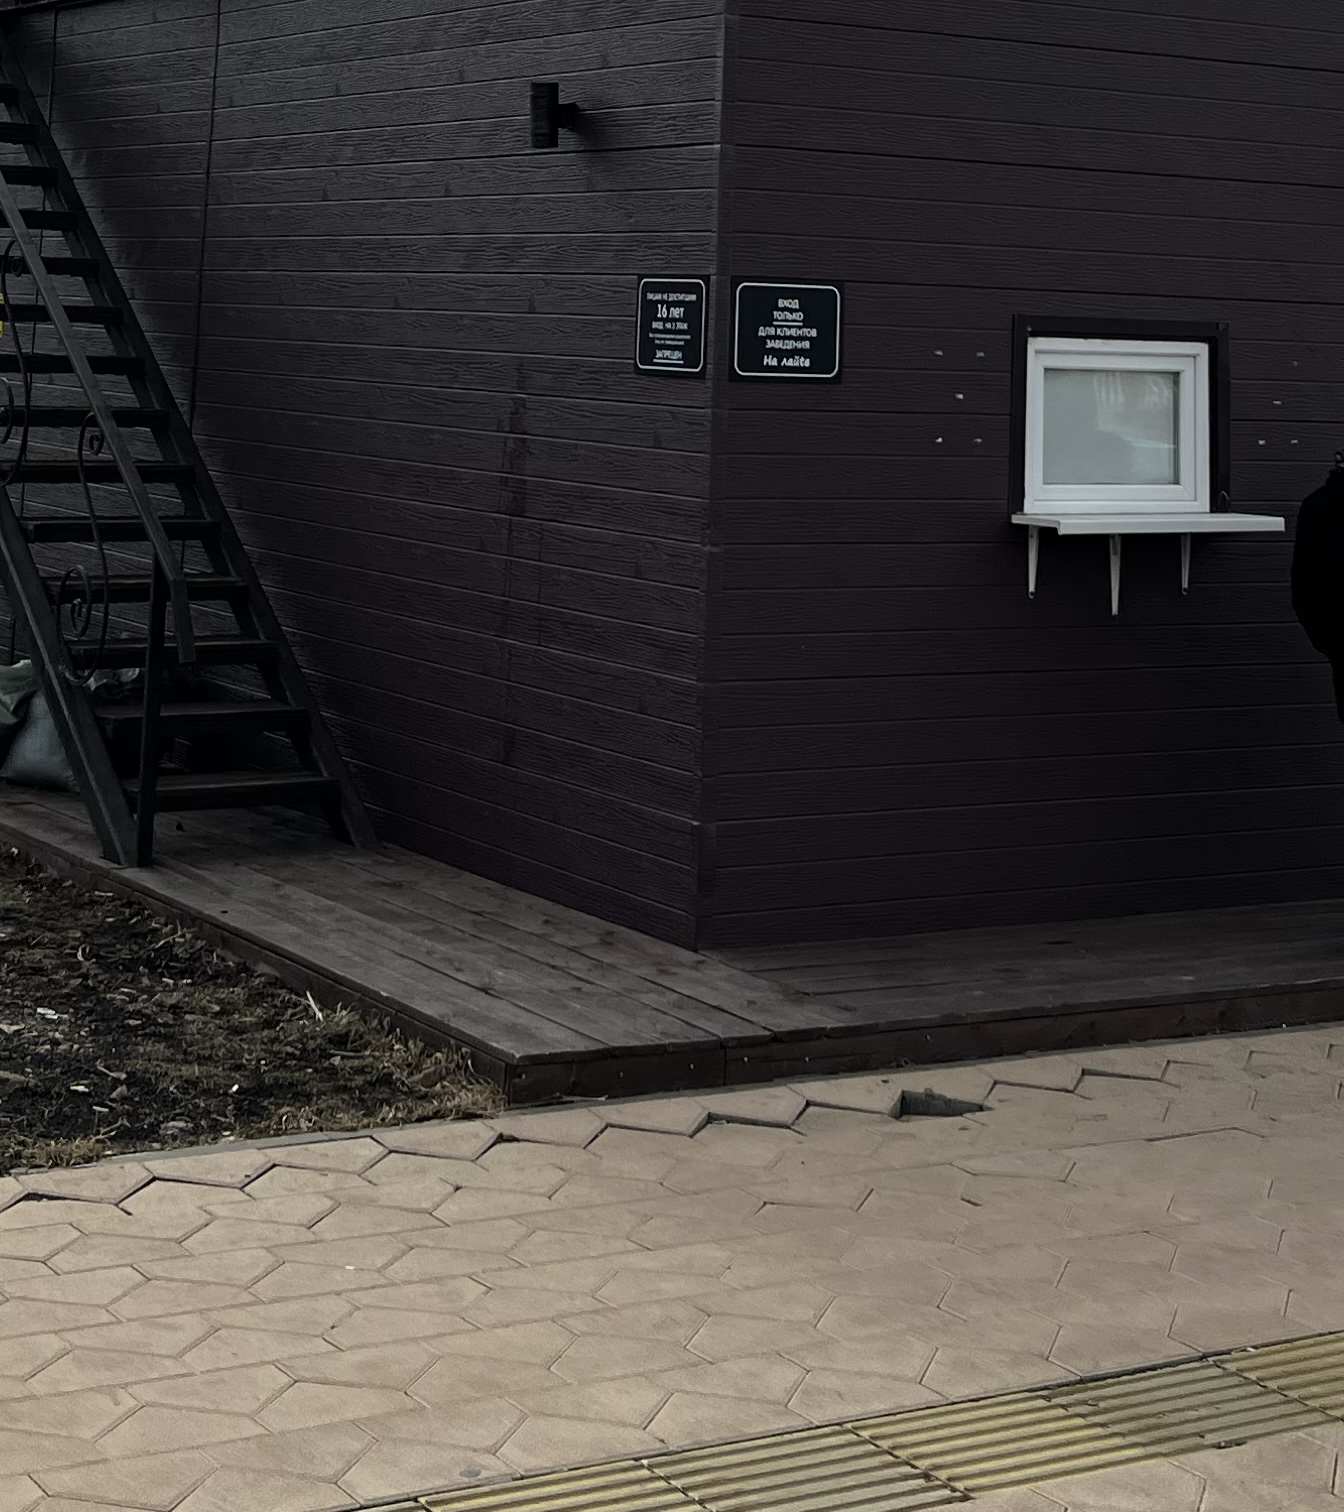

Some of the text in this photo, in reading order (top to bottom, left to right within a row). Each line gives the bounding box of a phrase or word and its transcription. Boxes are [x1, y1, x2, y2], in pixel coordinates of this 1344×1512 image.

[777, 298, 800, 310] ВХОД
[657, 303, 685, 319] 16 лет
[772, 310, 804, 322] ТОЛЬКО
[758, 326, 818, 338] ДЛЯ КЛИЕНТОВ
[765, 339, 811, 350] ЗАВЕДЕНИЯ
[763, 354, 778, 367] На
